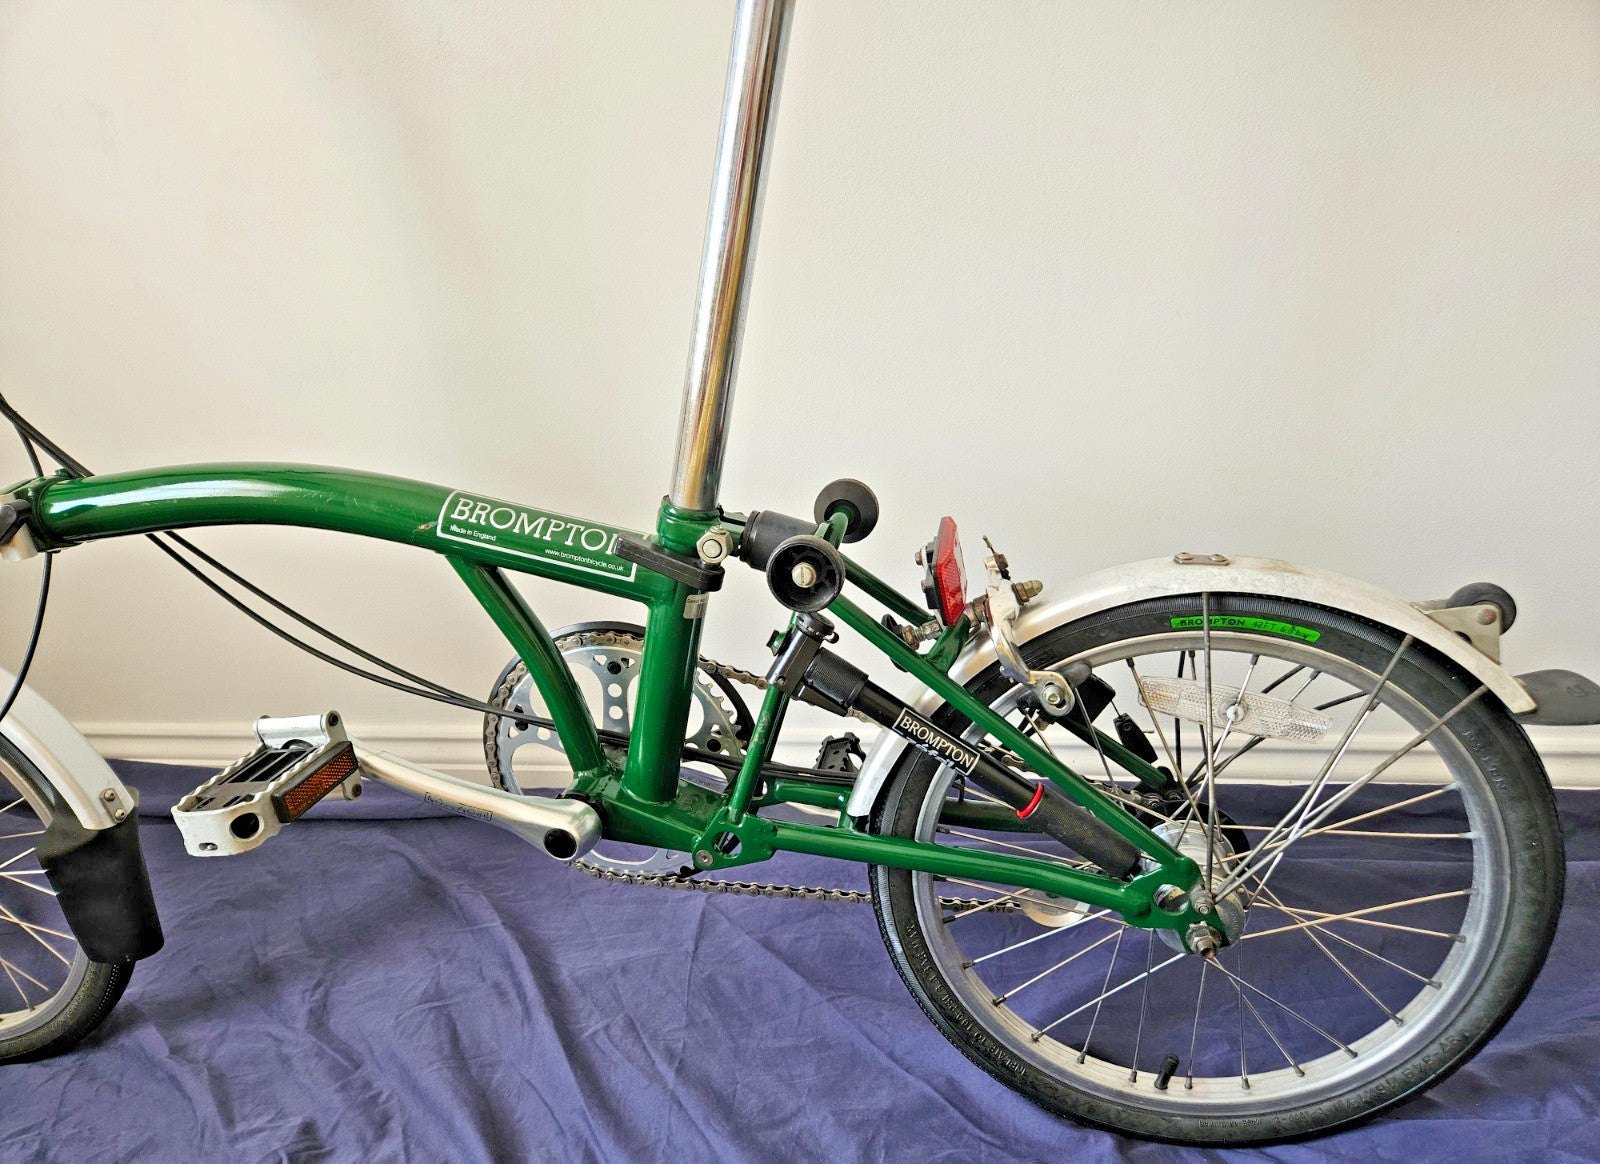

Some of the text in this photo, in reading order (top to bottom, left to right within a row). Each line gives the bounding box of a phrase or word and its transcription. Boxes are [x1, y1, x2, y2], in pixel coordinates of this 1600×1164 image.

[450, 524, 466, 535] Made
[473, 530, 497, 542] England
[545, 548, 625, 571] www.bromptonbicycle.co.uk
[900, 715, 975, 769] BROMPTON
